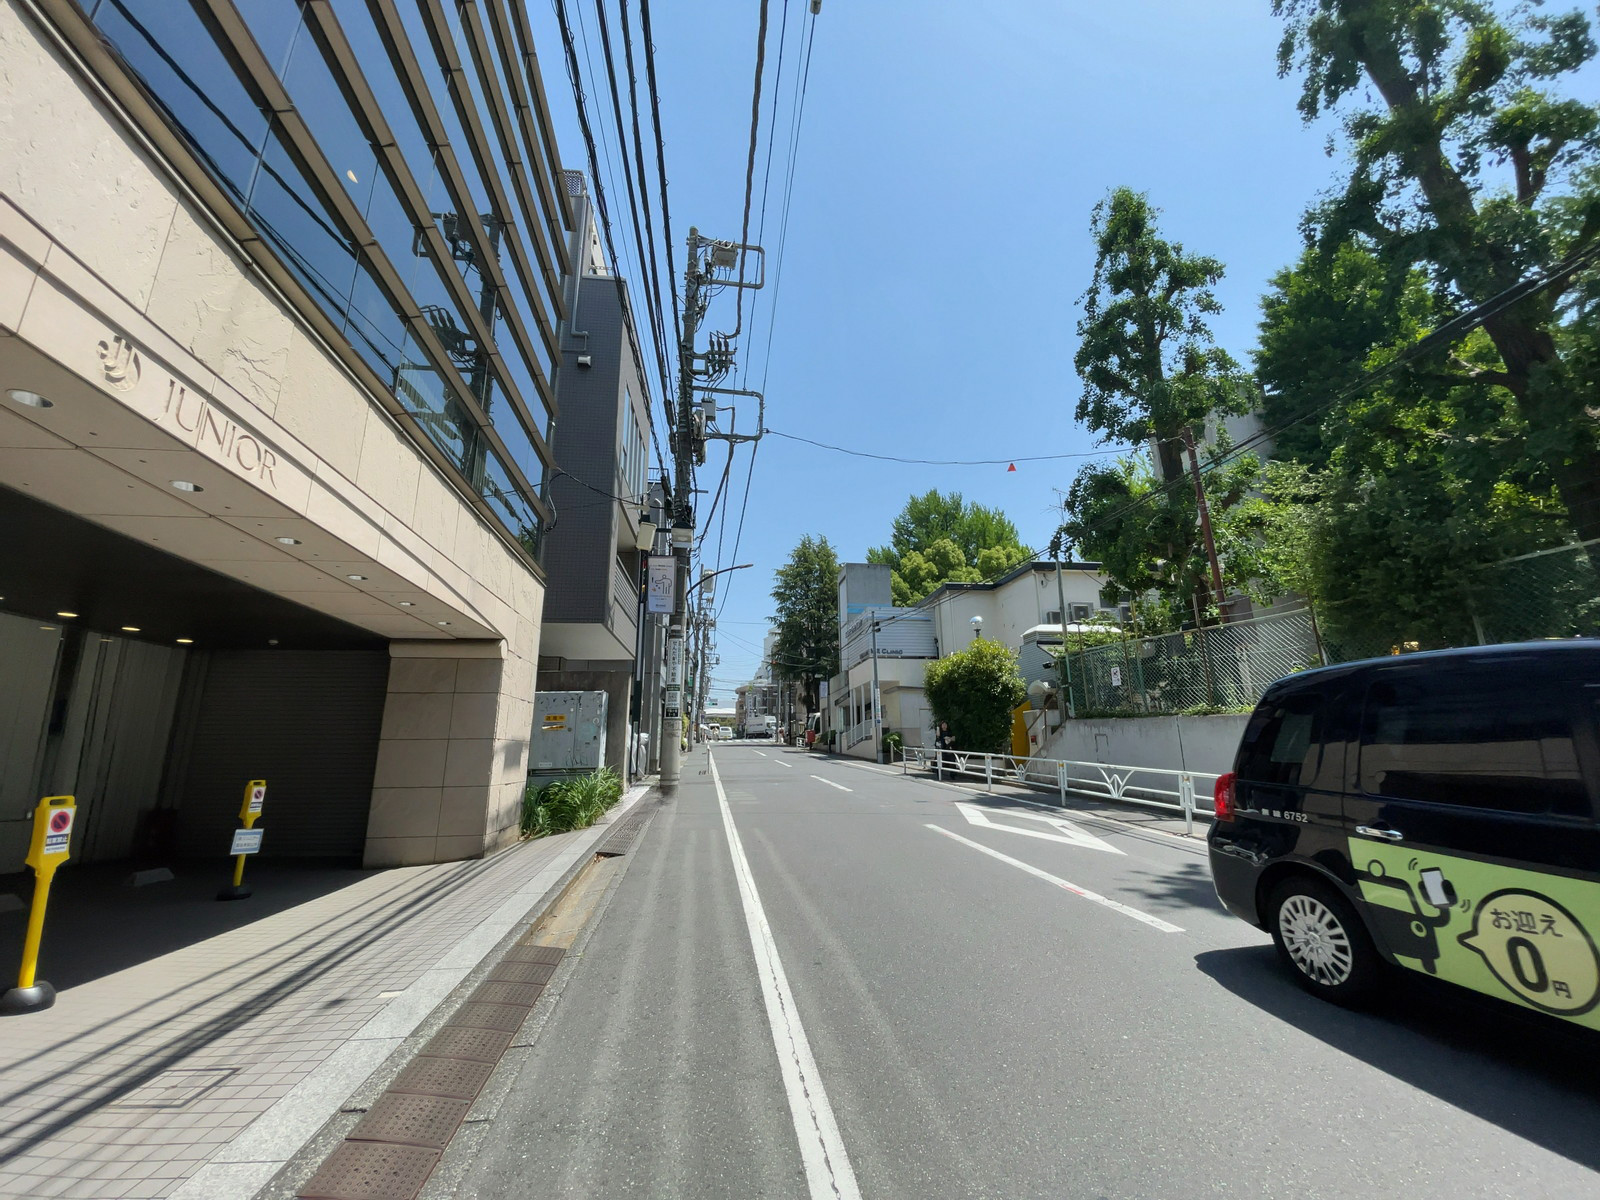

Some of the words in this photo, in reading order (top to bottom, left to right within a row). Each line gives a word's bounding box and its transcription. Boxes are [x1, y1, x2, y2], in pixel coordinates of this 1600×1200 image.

[153, 378, 278, 490] JUNIOR
[1283, 810, 1308, 823] 6752
[1490, 908, 1563, 938] お迎え
